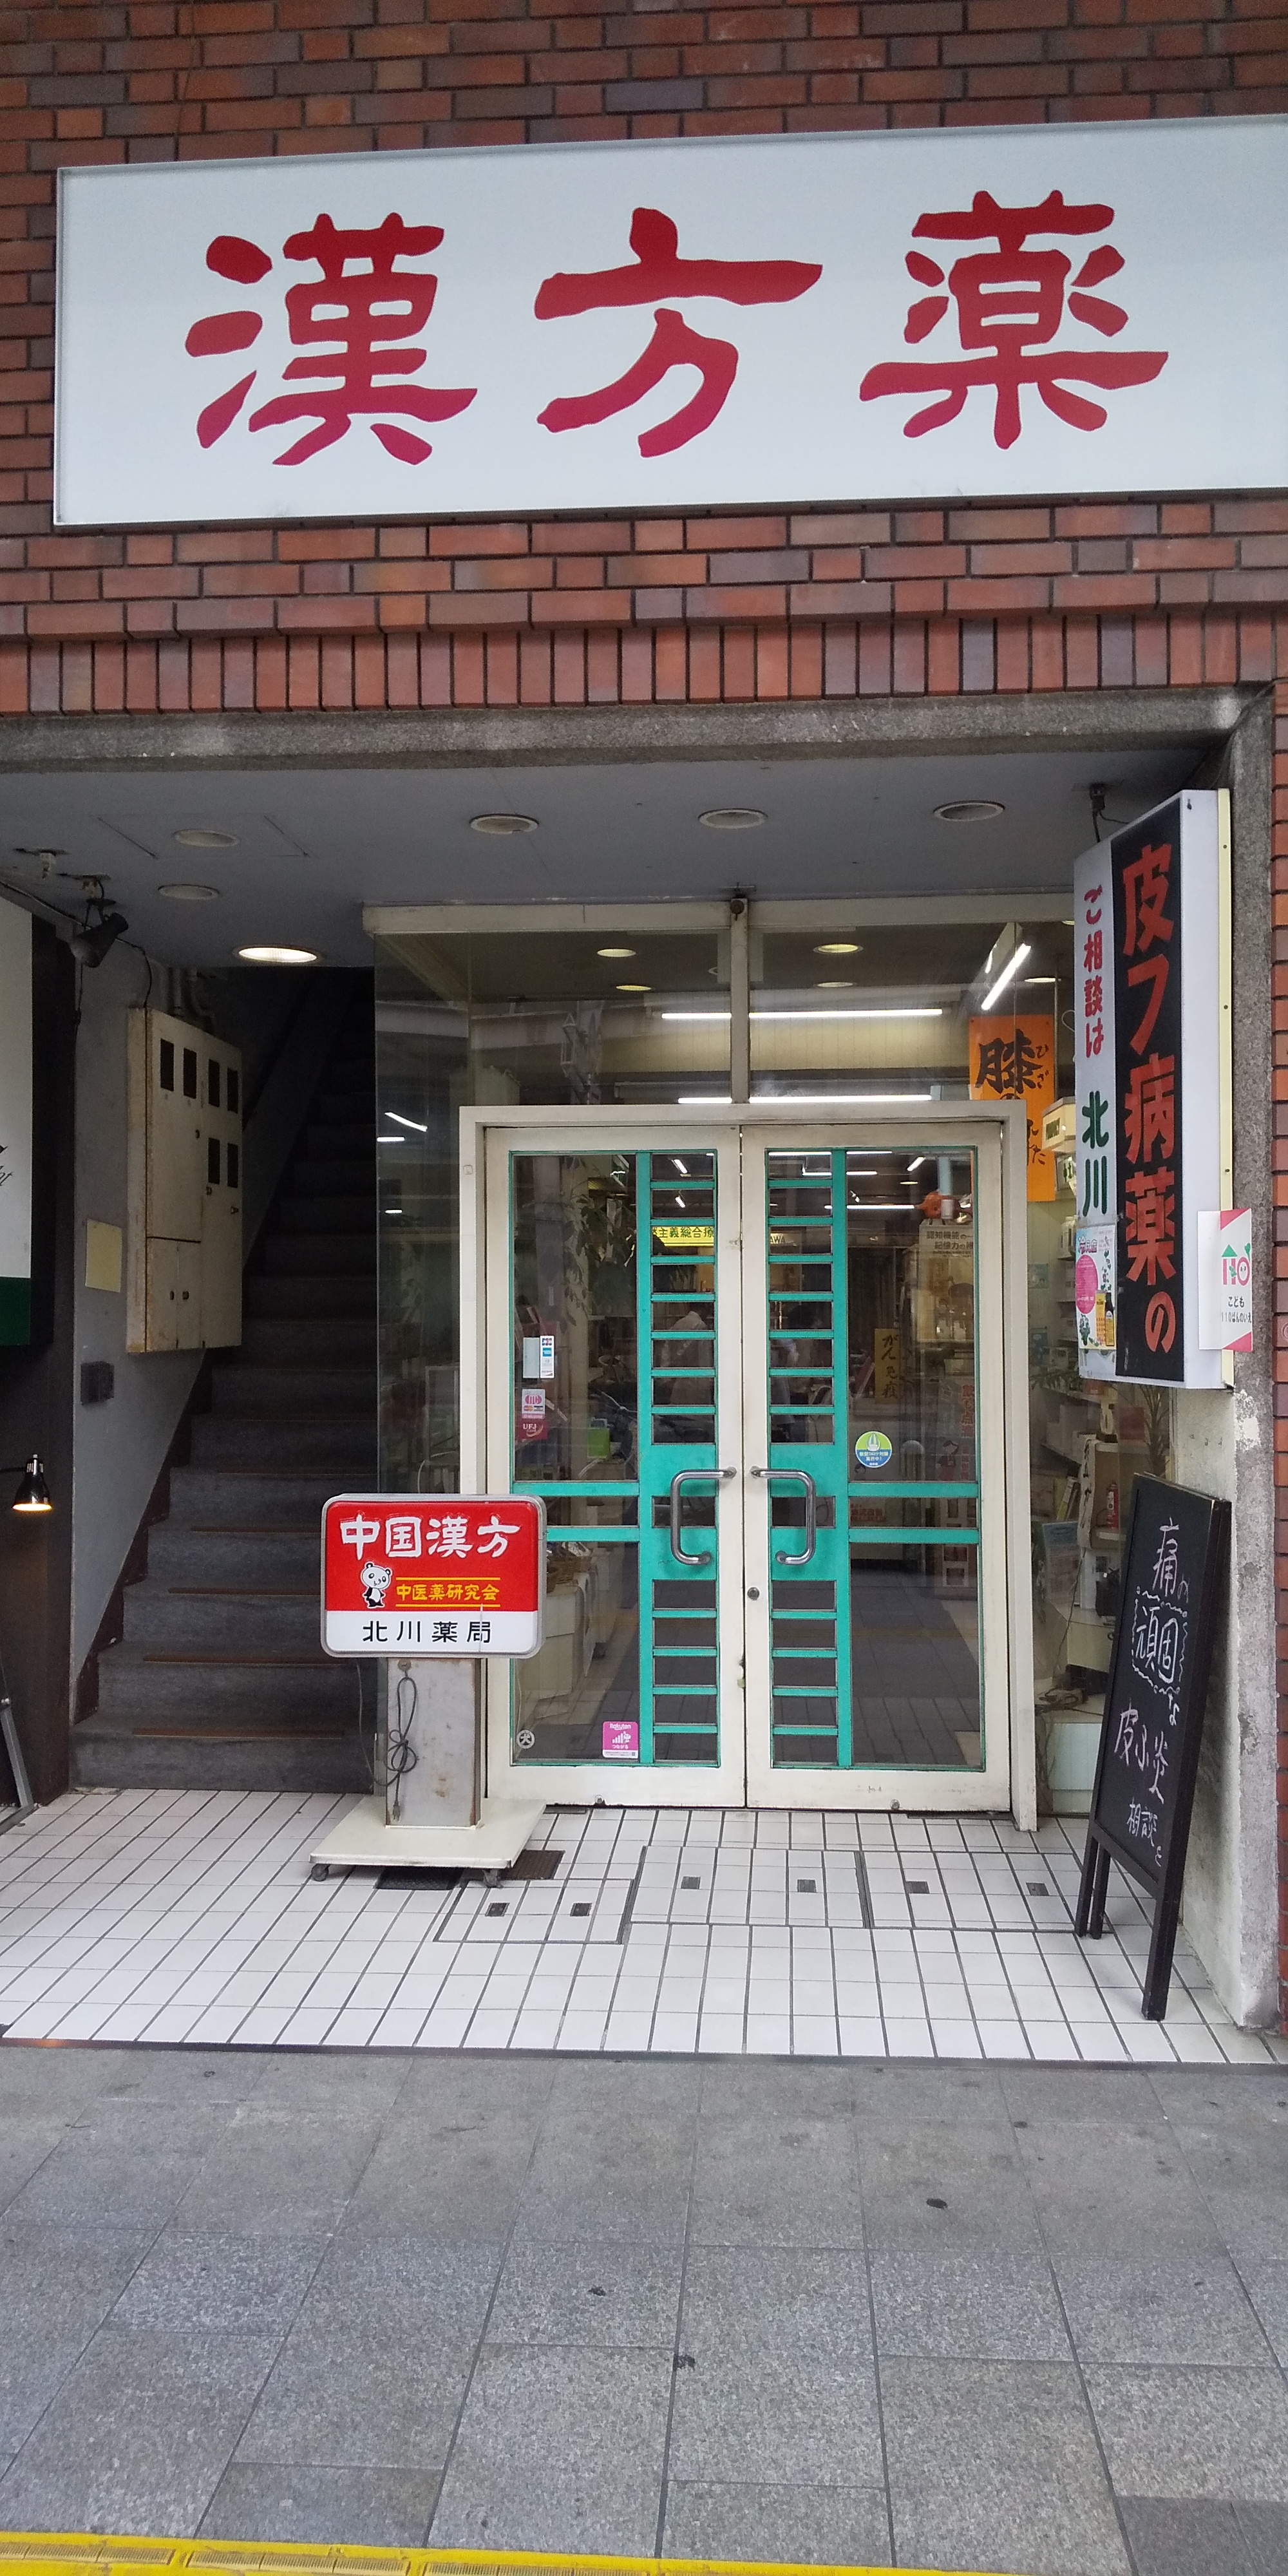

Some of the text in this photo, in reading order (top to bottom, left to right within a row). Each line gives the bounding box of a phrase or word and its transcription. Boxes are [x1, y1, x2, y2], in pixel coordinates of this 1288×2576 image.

[185, 189, 1170, 466] 漢方薬
[1083, 884, 1104, 1059] ご相談は
[975, 1028, 1043, 1099] 膝
[1122, 843, 1177, 1353] 皮フ病薬の
[1081, 1090, 1110, 1217] 北川
[1228, 1296, 1244, 1308] こども
[340, 1515, 521, 1560] 中国漢方
[395, 1584, 500, 1601] 中医薬研究会
[362, 1620, 491, 1643] 北川薬局
